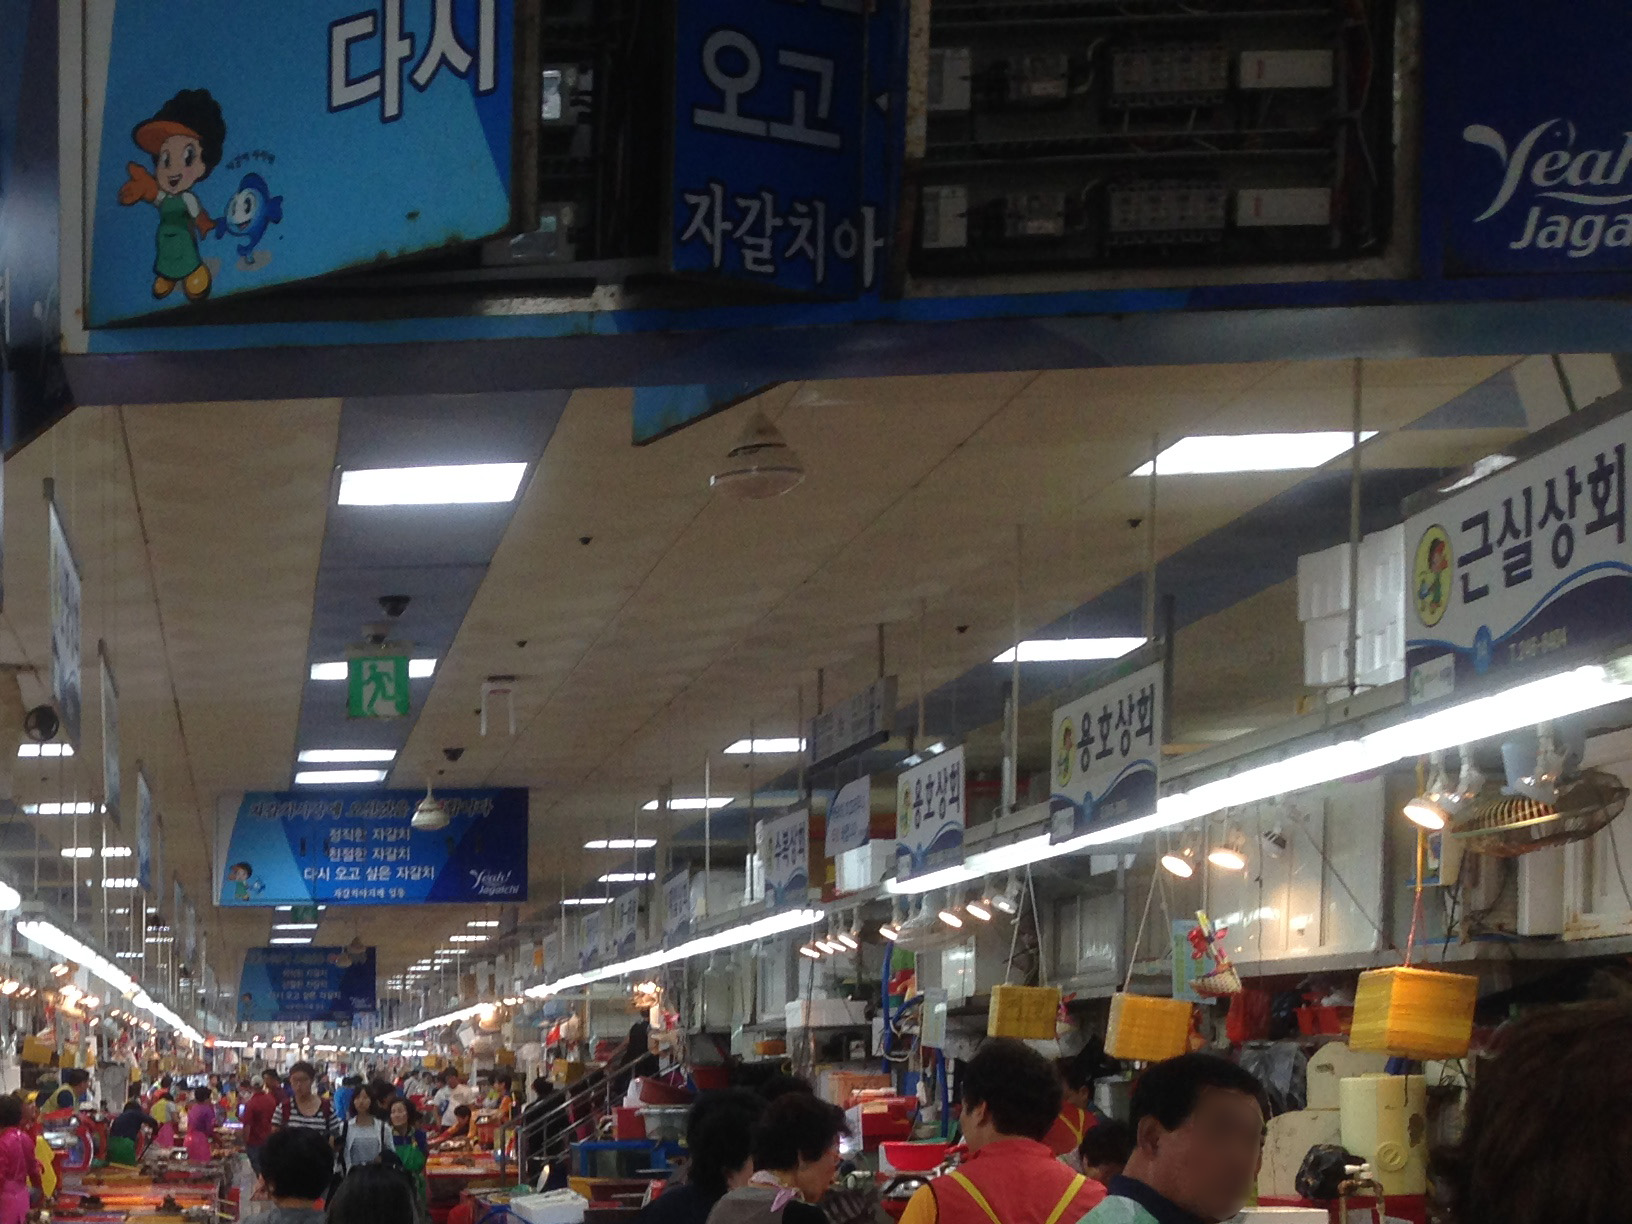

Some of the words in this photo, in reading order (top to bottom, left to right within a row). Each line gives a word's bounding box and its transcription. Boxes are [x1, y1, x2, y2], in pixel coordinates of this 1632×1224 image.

[330, 0, 496, 119] 다시
[694, 29, 842, 148] 오고
[683, 183, 885, 288] 자갈치아
[1457, 442, 1627, 604] 근실상회
[1077, 683, 1155, 773] 용호상회
[372, 827, 411, 842] 자갈치
[913, 760, 960, 830] 용호상회
[304, 866, 330, 881] 다시
[335, 866, 360, 881] 오고
[396, 865, 435, 880] 자갈치
[372, 846, 411, 861] 자갈치
